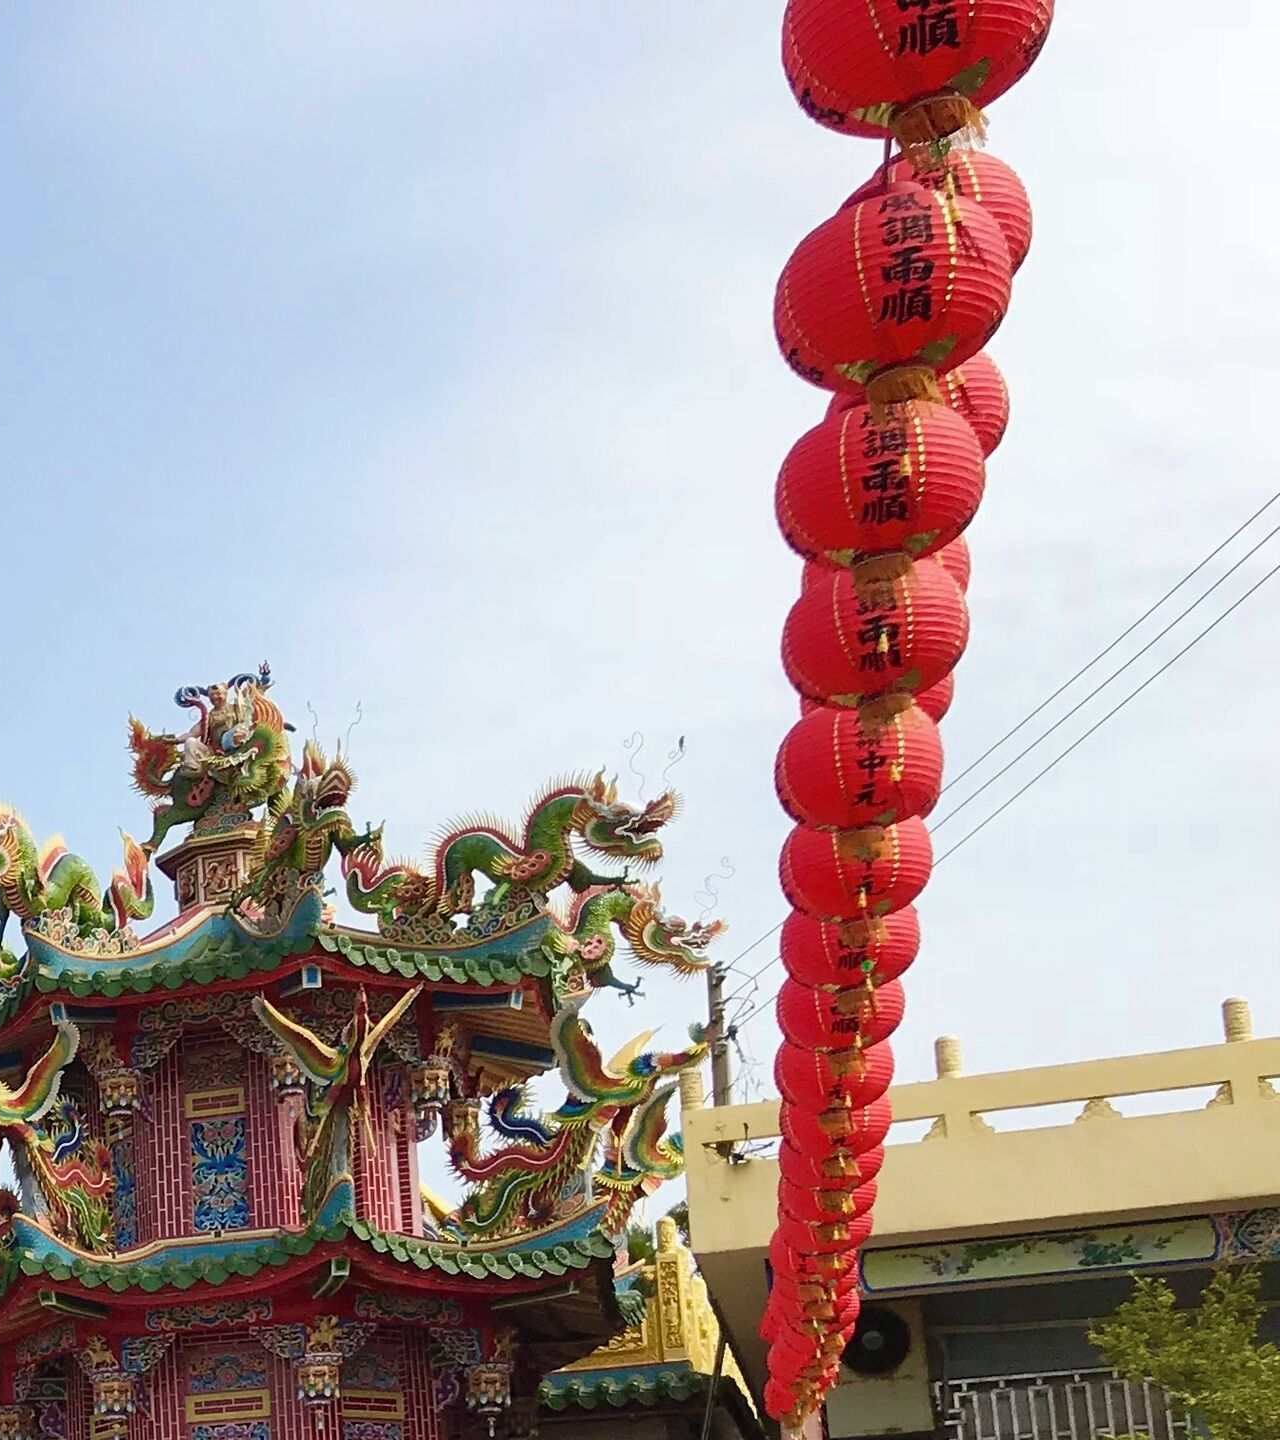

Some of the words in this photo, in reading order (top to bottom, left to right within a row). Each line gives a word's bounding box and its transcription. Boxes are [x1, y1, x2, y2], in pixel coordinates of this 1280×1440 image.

[896, 0, 961, 57] 順
[878, 191, 934, 325] 風調雨順
